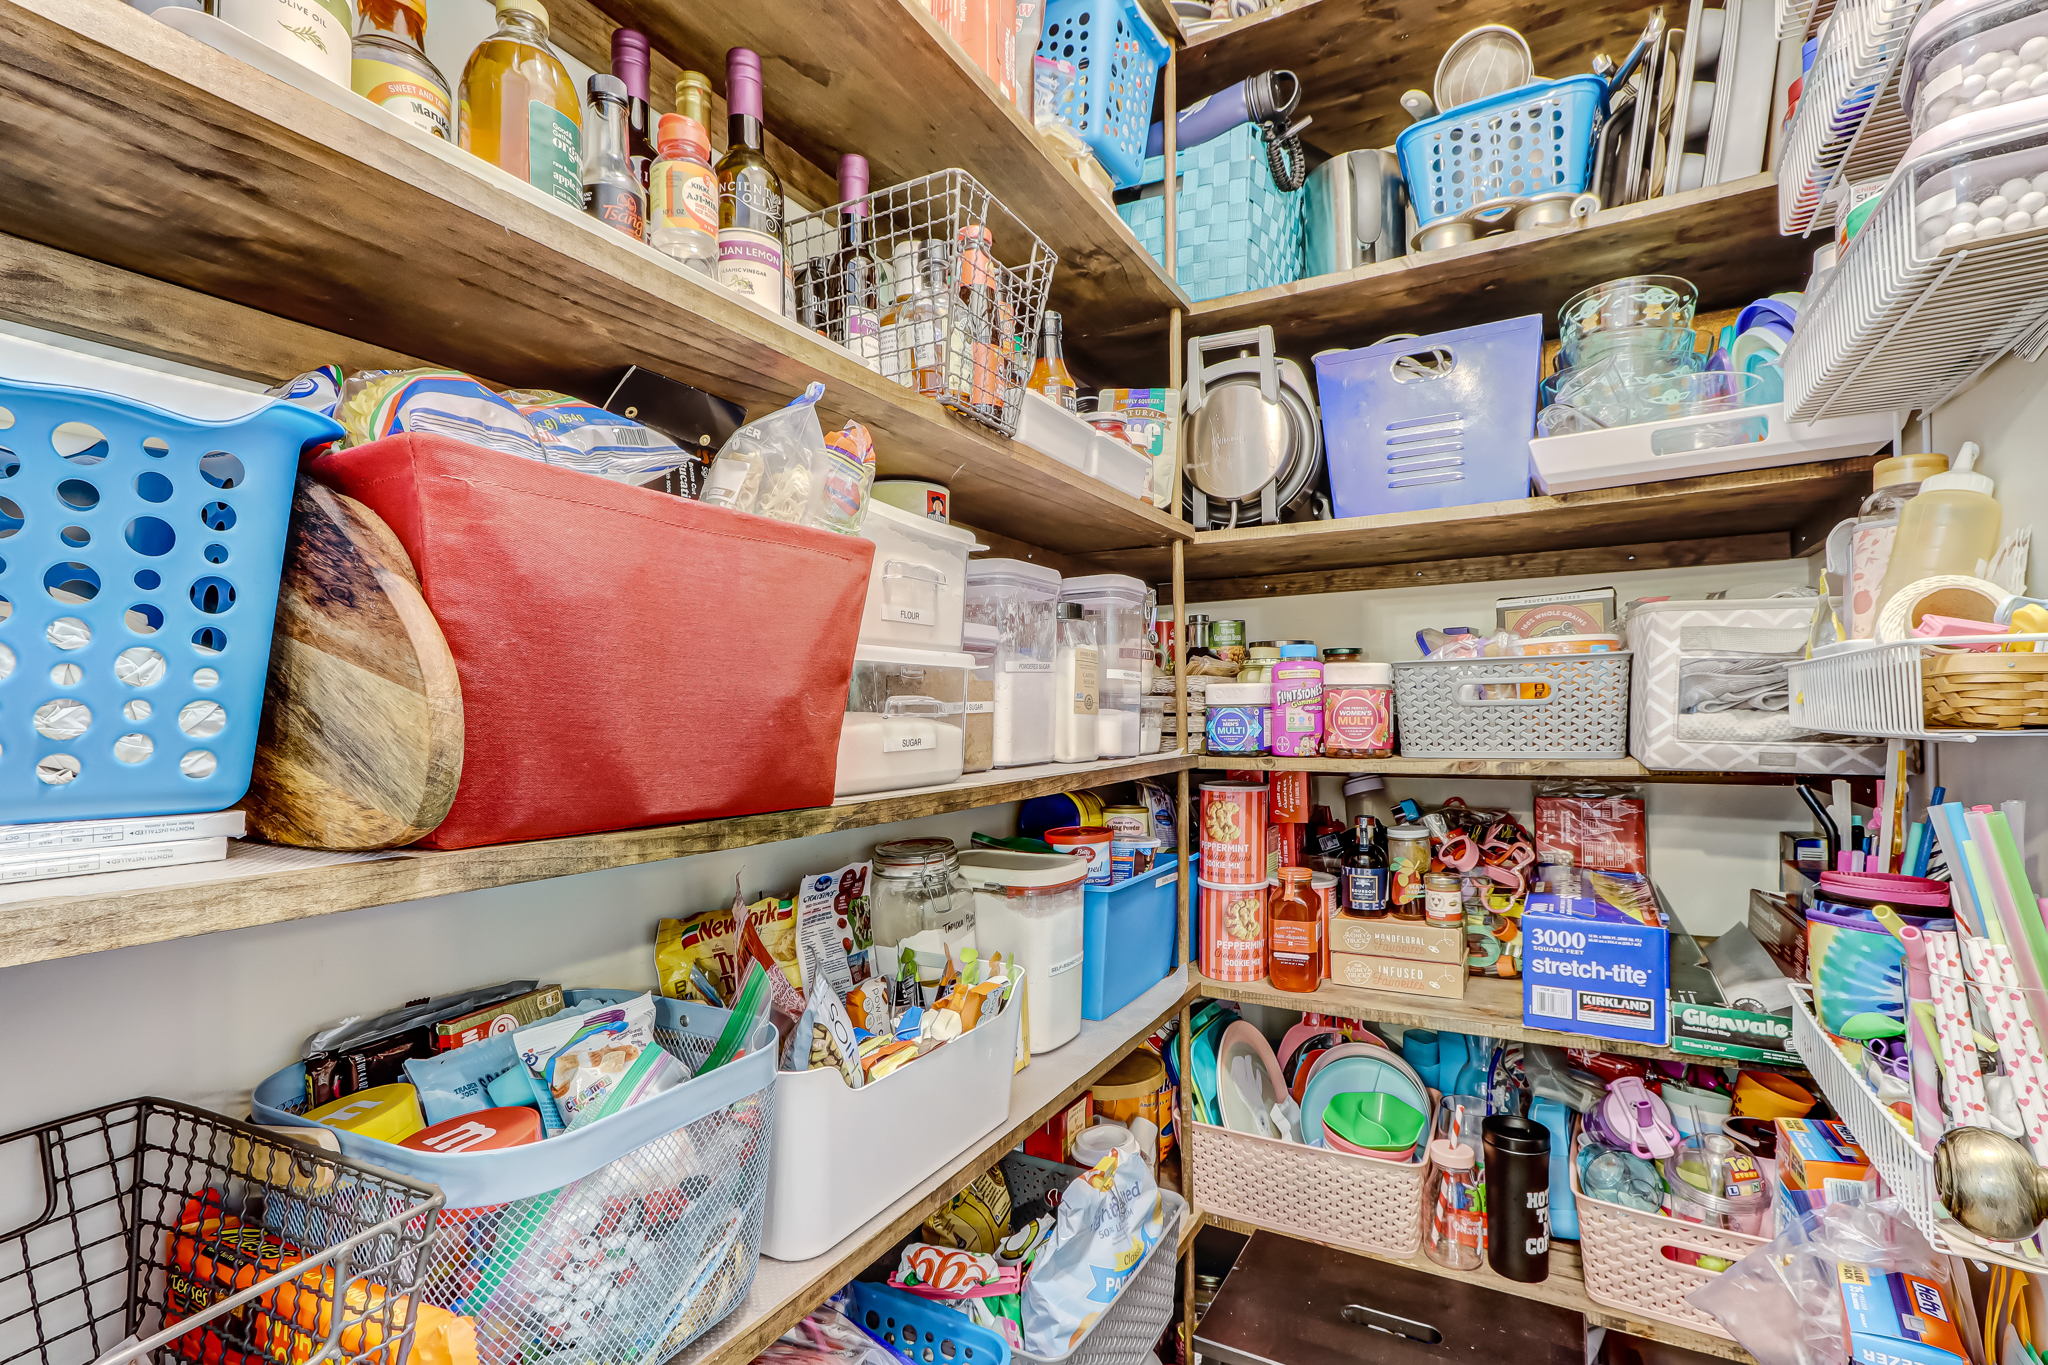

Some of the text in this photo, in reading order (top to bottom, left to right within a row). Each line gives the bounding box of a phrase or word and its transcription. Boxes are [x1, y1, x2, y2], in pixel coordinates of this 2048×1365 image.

[312, 13, 328, 29] OIL
[388, 84, 416, 95] SWEET
[418, 89, 435, 102] AND
[602, 204, 644, 236] Tsang
[746, 247, 780, 266] LEMON
[743, 268, 767, 277] VINEGAR
[1124, 409, 1162, 419] ATURAL
[900, 610, 920, 620] FLOUR
[1535, 610, 1561, 621] WHOLE
[1561, 611, 1588, 627] GRAINS
[1276, 683, 1323, 706] FLINTSTONES
[968, 703, 984, 712] SUGAR
[1291, 697, 1321, 708] Gummies
[1337, 716, 1374, 726] MULTI
[1217, 727, 1245, 735] MULTI
[902, 738, 922, 748] SUGAR
[135, 827, 169, 835] INSTALLED
[1201, 841, 1249, 853] PEPPERMINT
[111, 853, 174, 864] MONTH INSTALLED
[1352, 900, 1387, 911] BEES
[699, 918, 737, 941] New
[748, 901, 778, 927] ork
[1374, 933, 1425, 946] MONOFLORAL
[1531, 928, 1586, 949] 3000
[1533, 945, 1585, 956] SQUARE FEET
[1224, 959, 1250, 967] COOKIE
[1378, 965, 1423, 980] INFUSED
[1532, 957, 1648, 985] stretch-tite
[1582, 994, 1650, 1012] KIRKLAND
[1682, 1008, 1789, 1038] Glenvale
[454, 1082, 478, 1095] TRADER
[1723, 1155, 1754, 1172] TOY
[1917, 1283, 1941, 1317] Hefty
